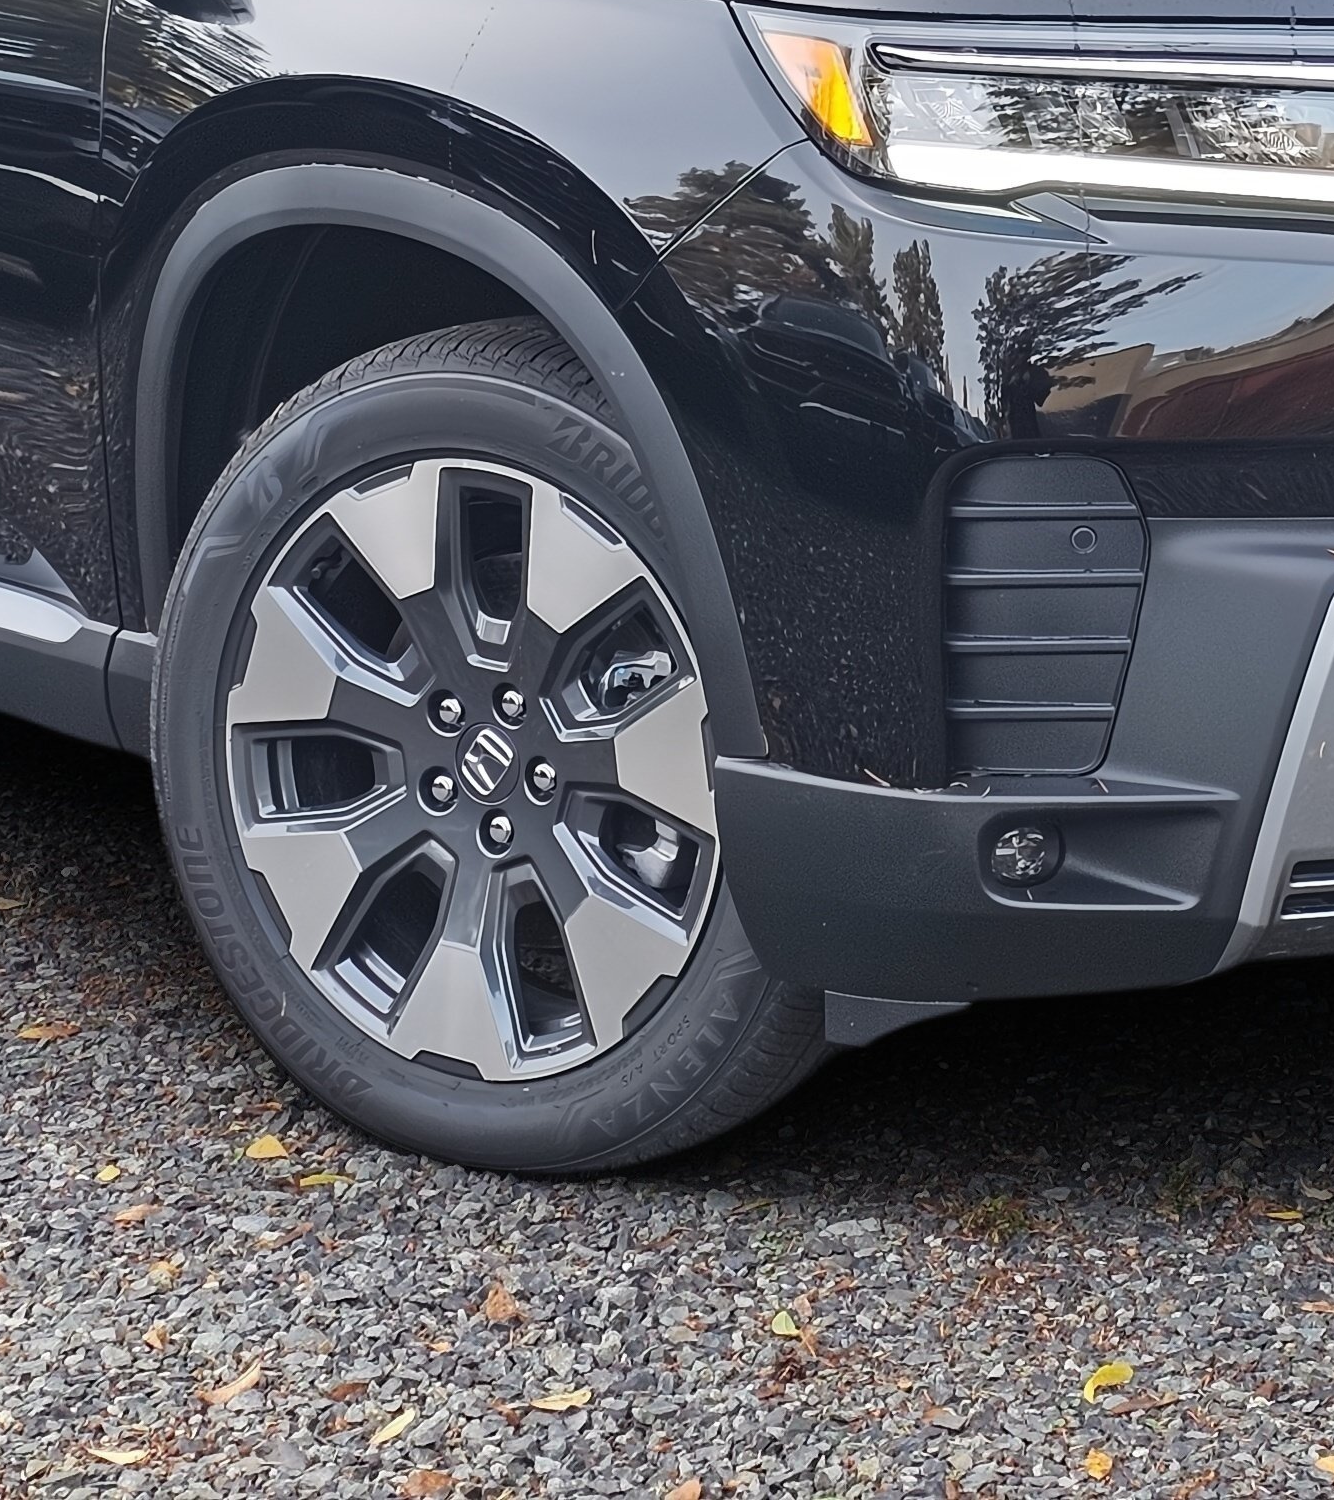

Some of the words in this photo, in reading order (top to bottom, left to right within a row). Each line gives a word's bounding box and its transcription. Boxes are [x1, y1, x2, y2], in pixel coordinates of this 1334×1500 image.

[175, 826, 374, 1104] BRIDGESTONE
[591, 991, 739, 1137] ALENZA
[620, 1062, 644, 1088] A/S
[653, 1014, 691, 1062] SPORT
